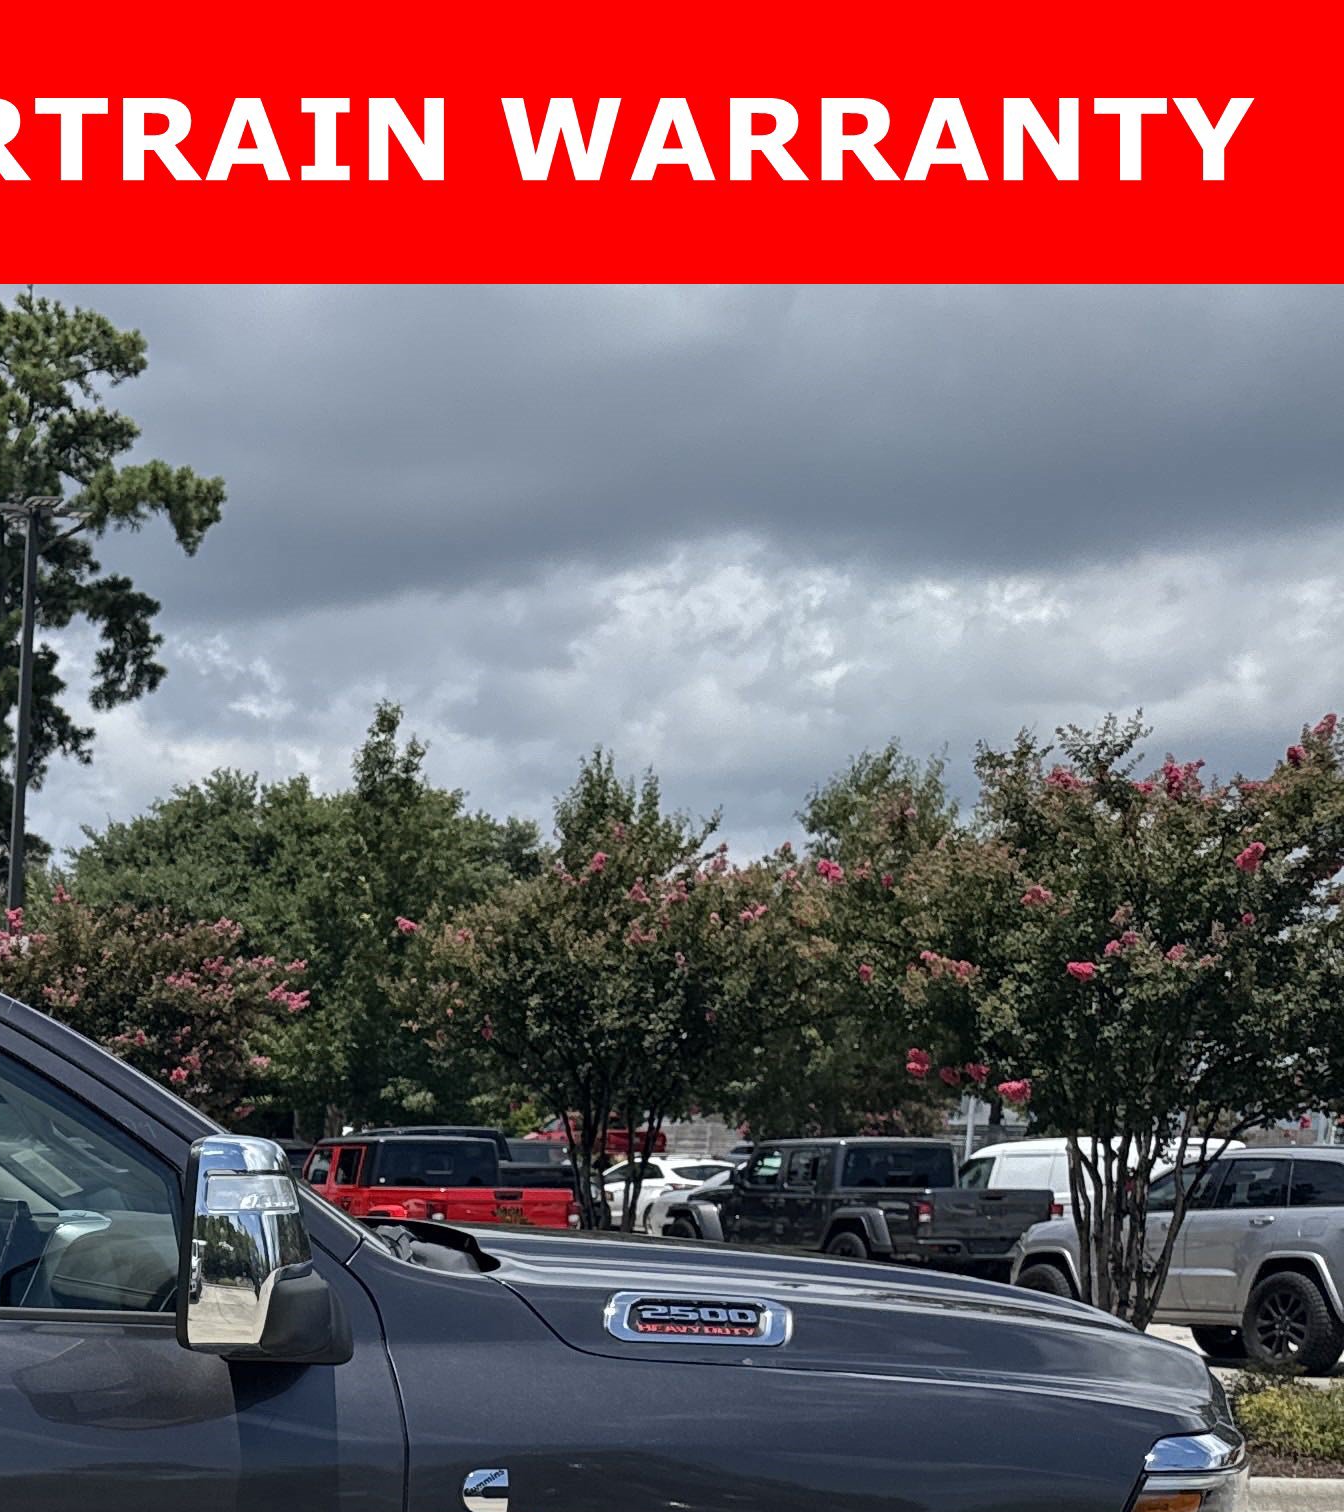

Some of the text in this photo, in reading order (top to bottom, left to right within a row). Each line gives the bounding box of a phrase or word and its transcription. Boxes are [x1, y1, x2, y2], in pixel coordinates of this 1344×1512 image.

[637, 1304, 758, 1325] 2500
[637, 1322, 756, 1337] HEAVY DUTY
[463, 1469, 505, 1497] Cummins
